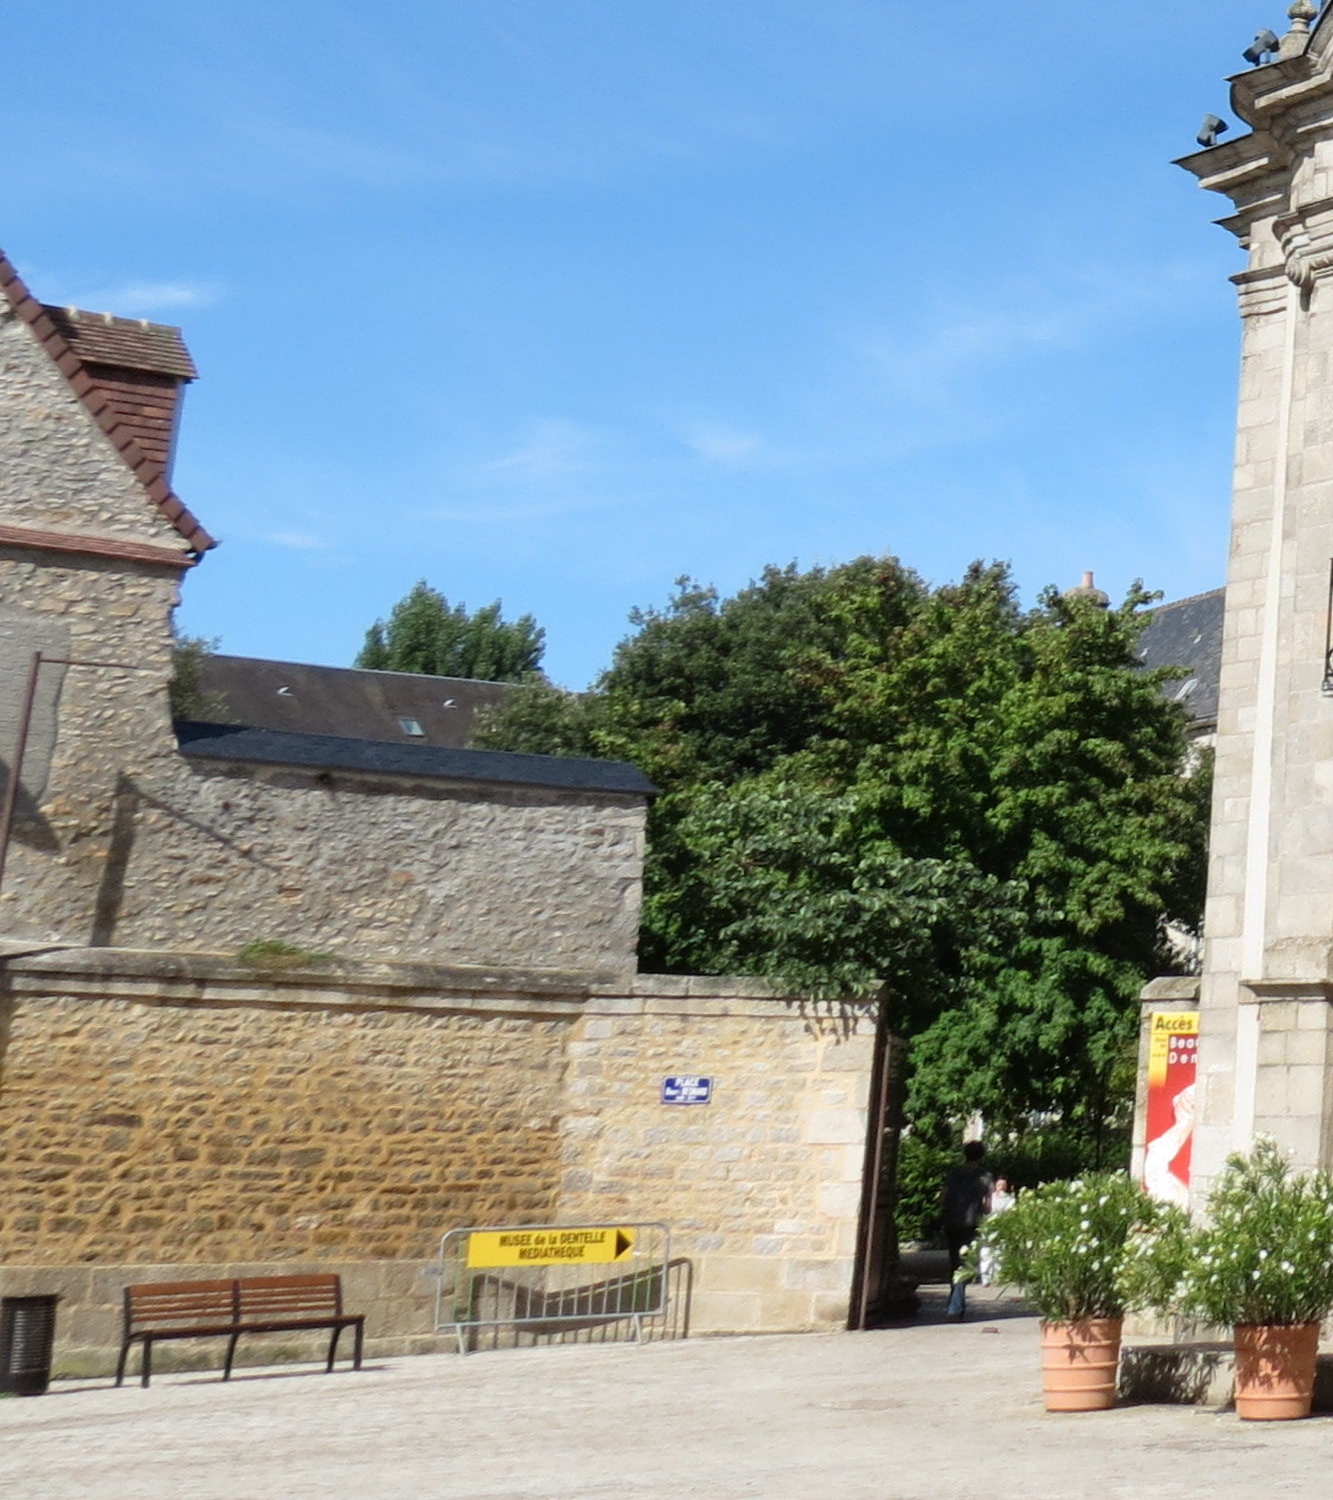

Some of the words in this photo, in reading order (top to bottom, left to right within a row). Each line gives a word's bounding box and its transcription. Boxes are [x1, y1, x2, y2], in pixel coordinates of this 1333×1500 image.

[500, 1235, 532, 1246] MUSEE
[534, 1235, 546, 1245] de
[549, 1234, 557, 1244] la
[560, 1231, 606, 1243] DENTELLE
[519, 1246, 584, 1259] MEDIATHEQUE
